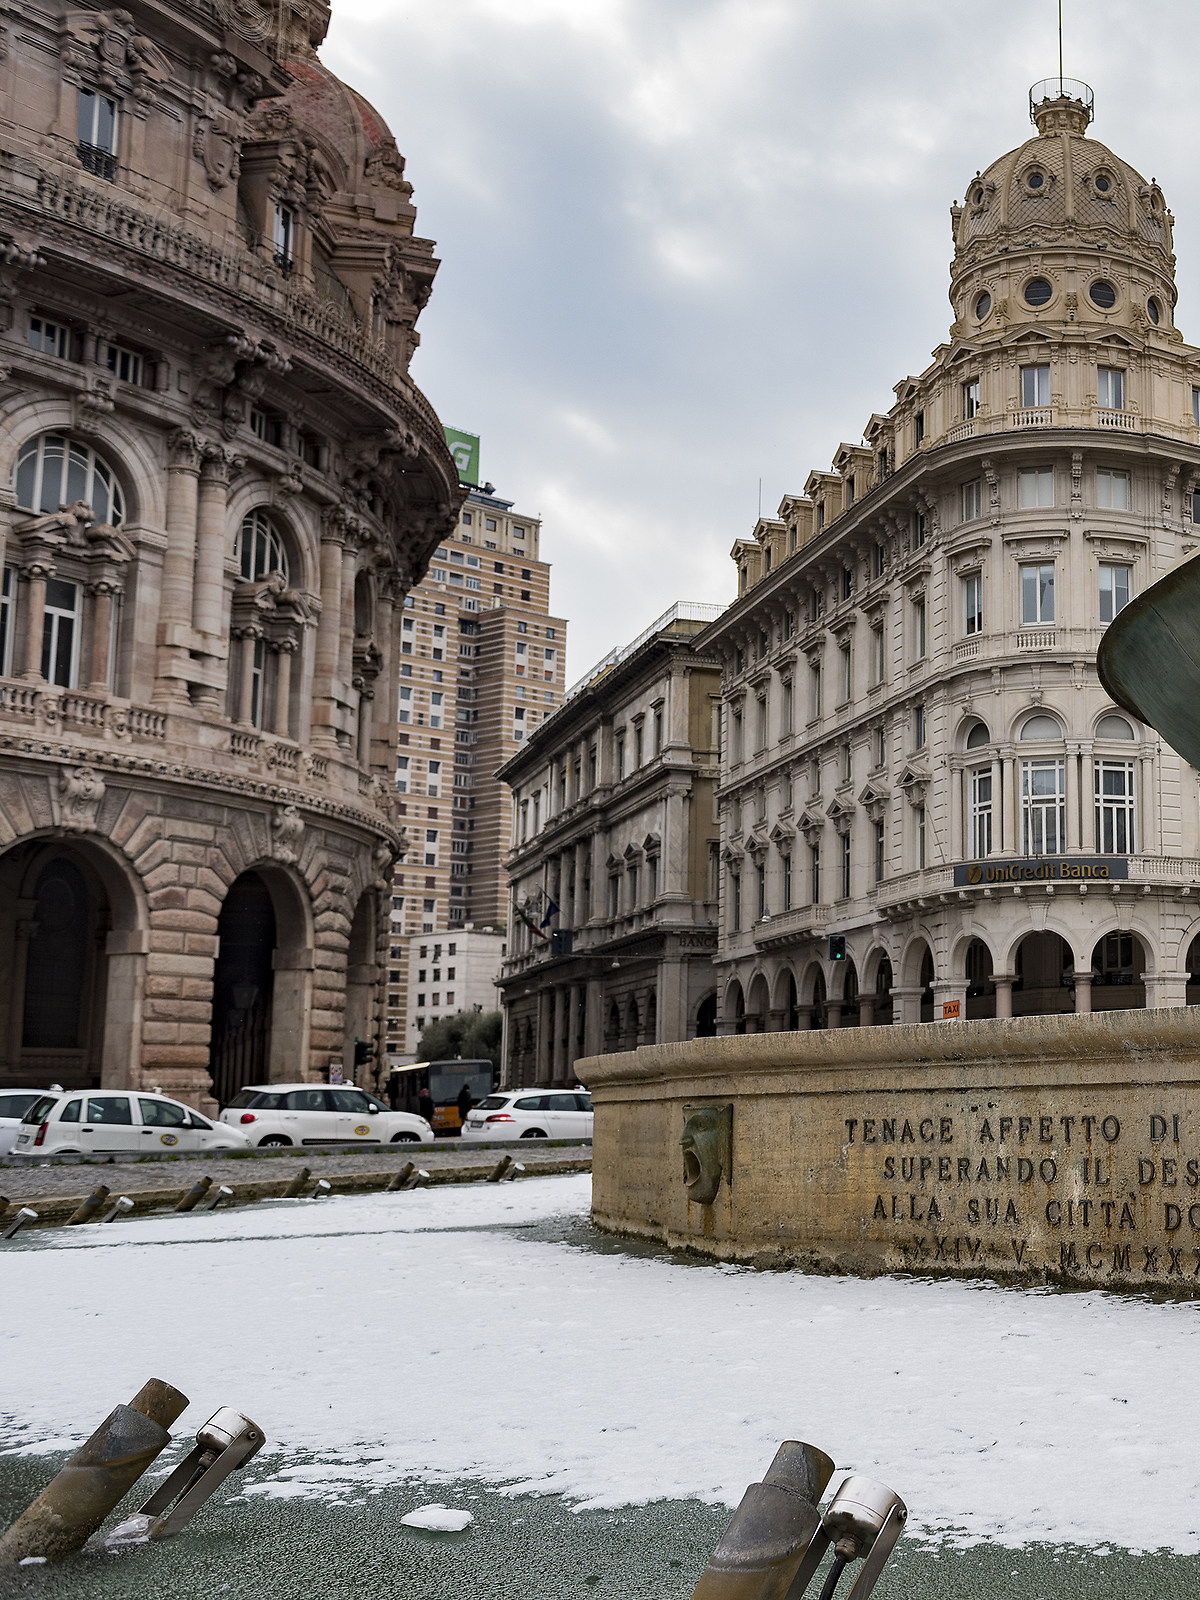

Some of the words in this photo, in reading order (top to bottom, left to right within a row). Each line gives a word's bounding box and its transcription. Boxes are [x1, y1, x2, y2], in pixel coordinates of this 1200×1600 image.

[986, 862, 1056, 881] UniCredit
[1060, 862, 1109, 878] Banca
[680, 937, 718, 948] BANCA
[943, 1005, 959, 1014] TAXI
[845, 1117, 953, 1143] TENACE
[979, 1114, 1121, 1143] AFFETTO
[1150, 1114, 1180, 1142] DI
[883, 1156, 1057, 1184] SUPERANDO
[1082, 1157, 1109, 1185] IL
[873, 1194, 943, 1222] ALLA
[967, 1198, 1019, 1225] SUA
